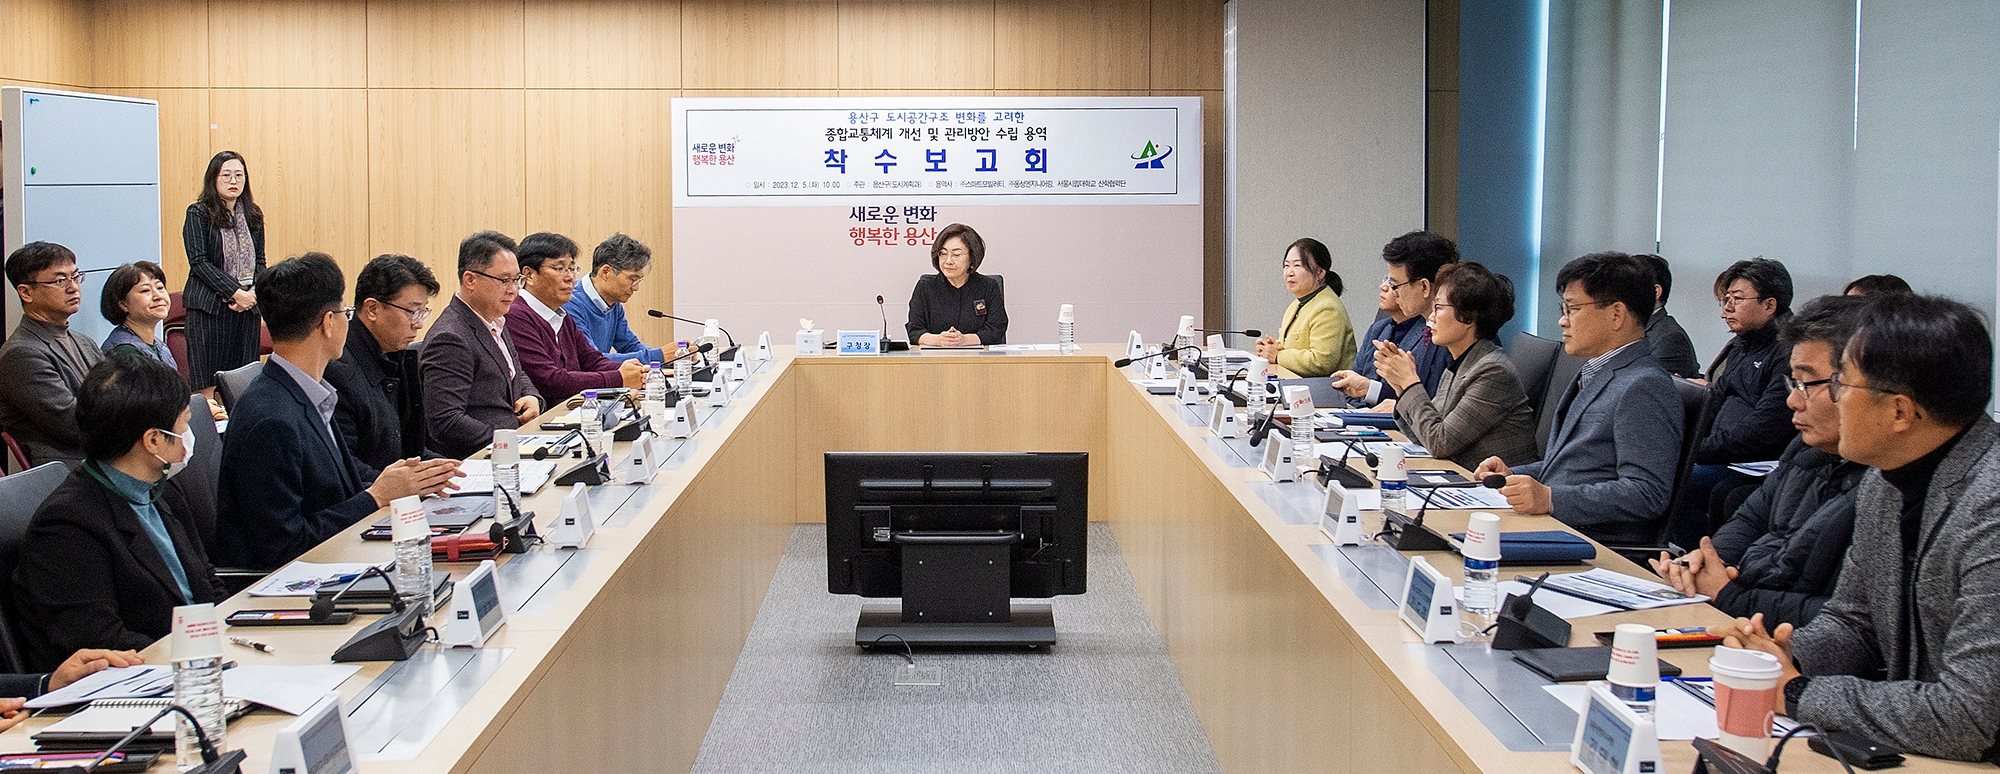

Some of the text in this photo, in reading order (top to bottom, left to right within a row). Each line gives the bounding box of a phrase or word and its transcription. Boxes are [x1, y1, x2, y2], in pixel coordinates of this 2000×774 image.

[848, 111, 1025, 125] 용산구 도시공간구조 변화를 고려한
[825, 126, 1047, 142] 종합교통체계 개선 및 관리방안 수립 용역
[692, 143, 735, 154] 새로운 변화
[692, 154, 735, 166] 행복한 용산
[849, 206, 937, 224] 새로운 변화
[849, 227, 937, 246] 행복한 용산
[846, 341, 871, 351] 구청장
